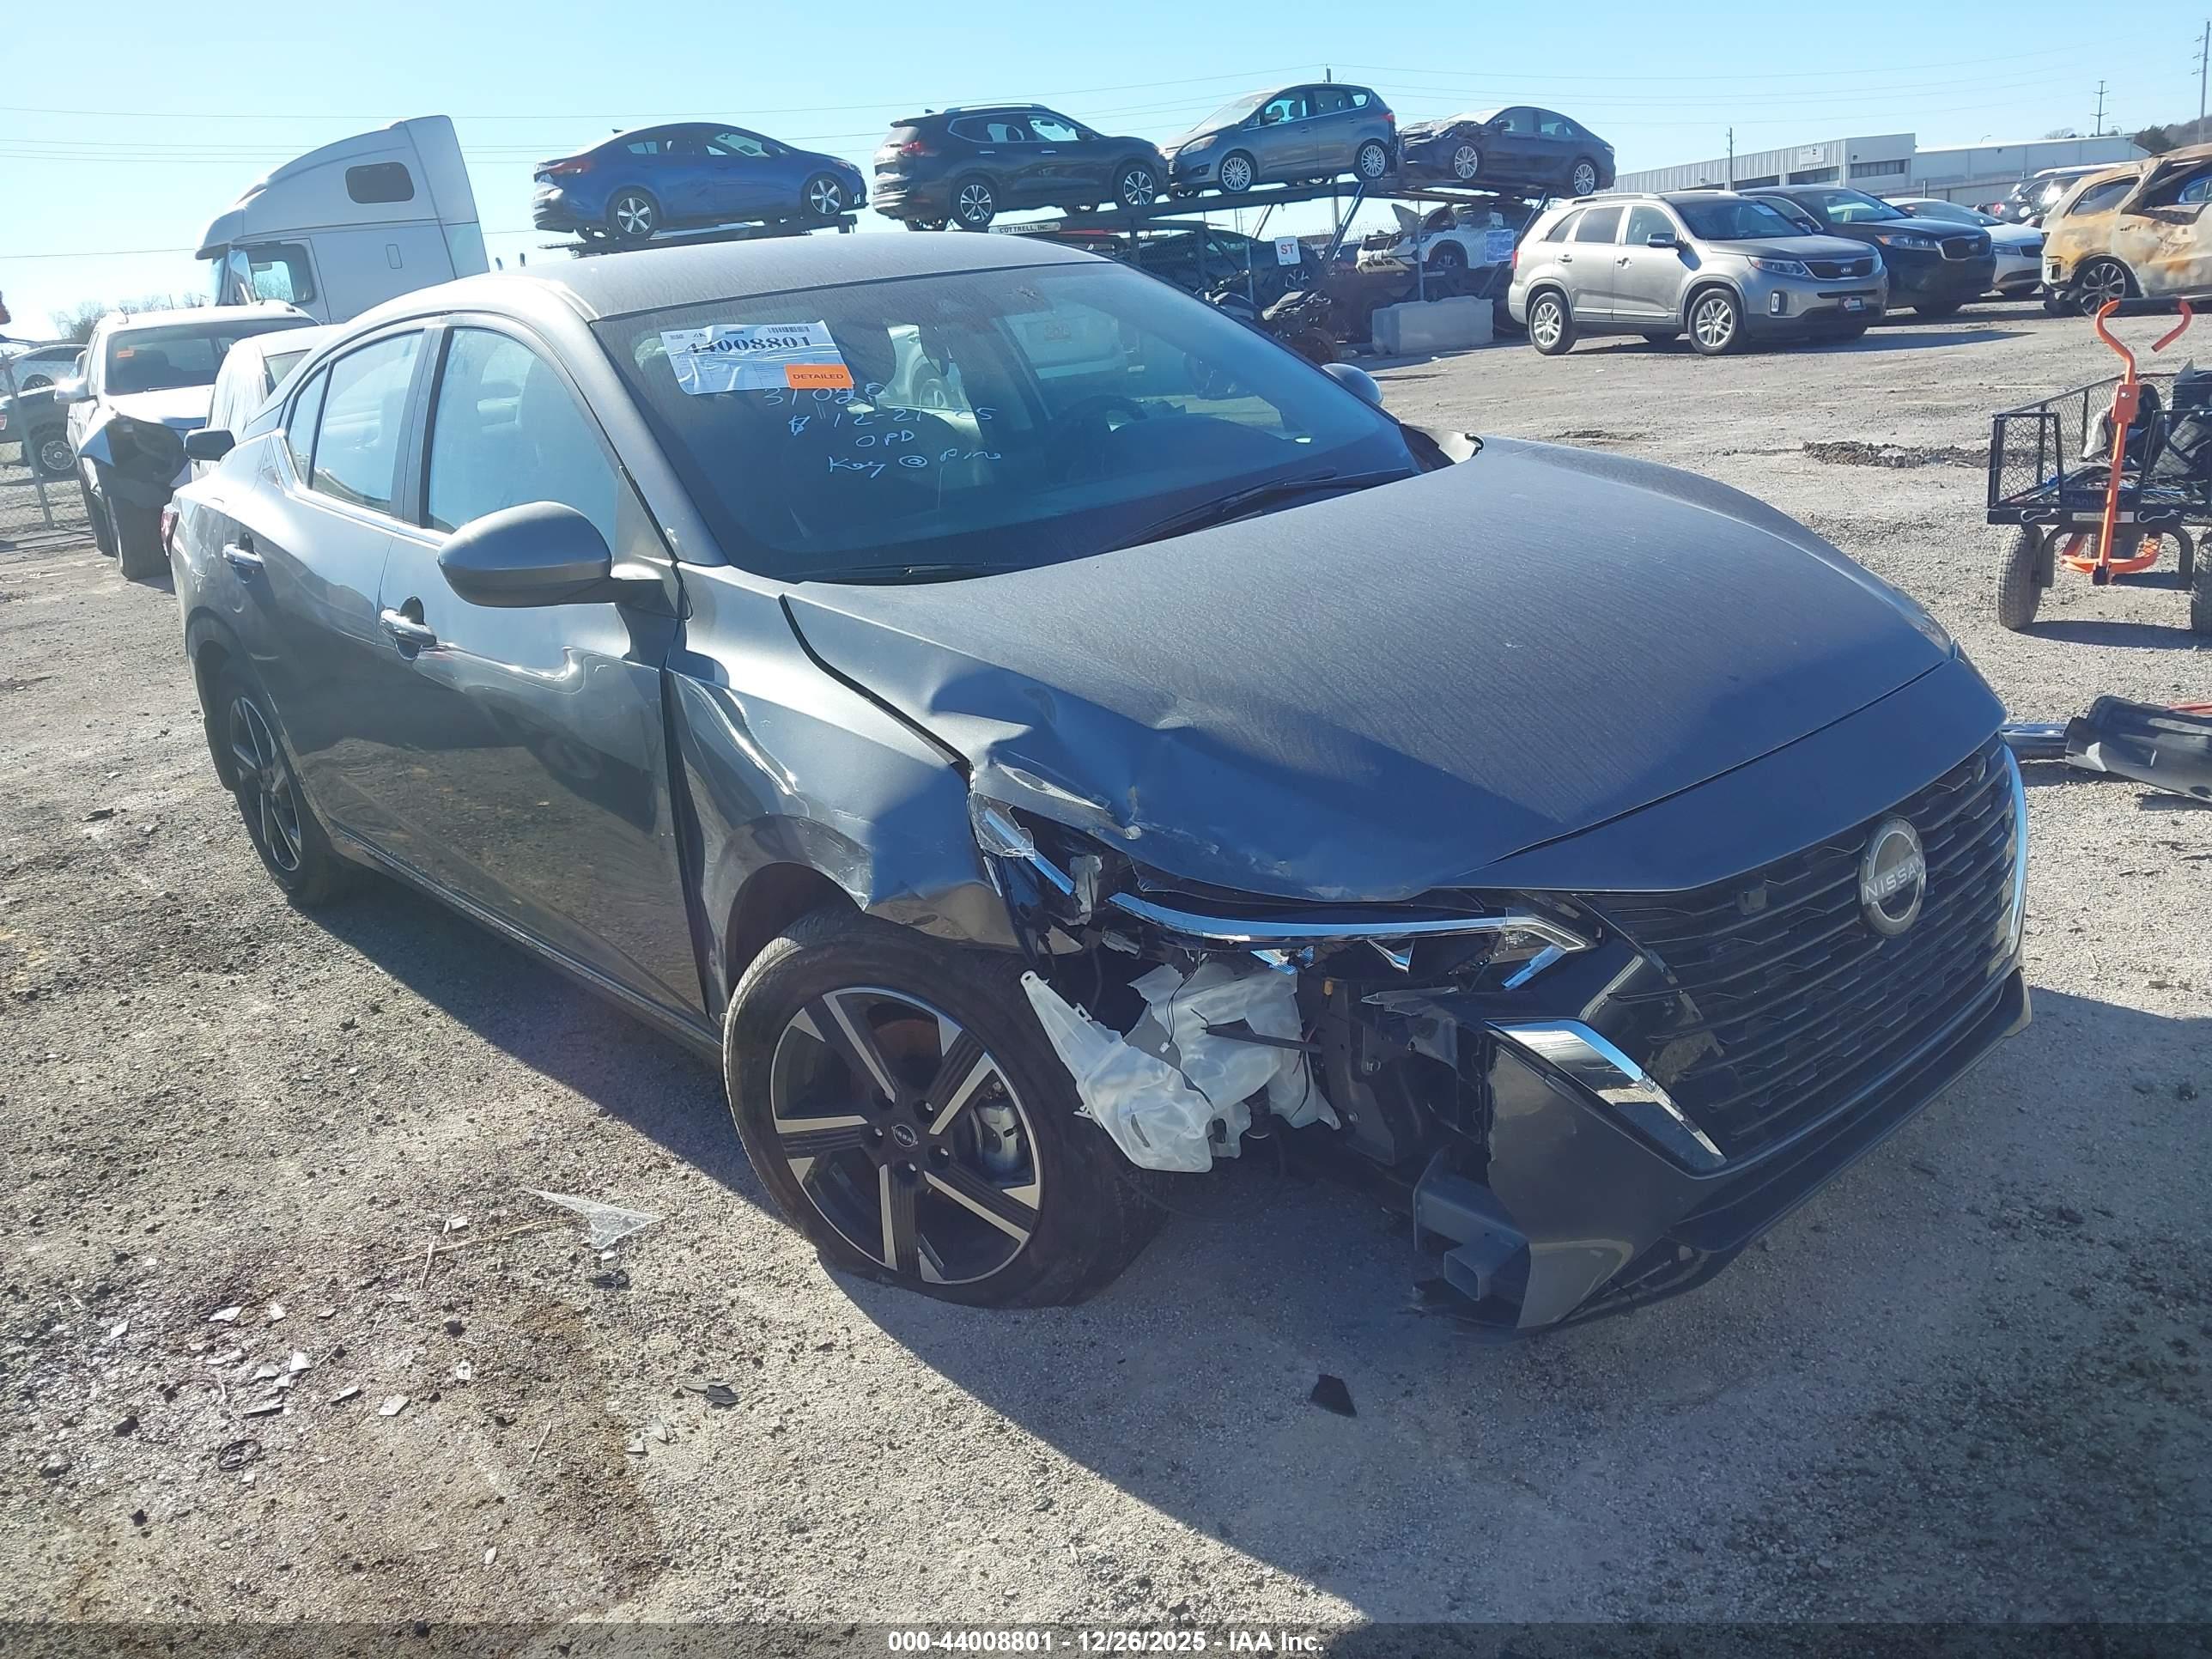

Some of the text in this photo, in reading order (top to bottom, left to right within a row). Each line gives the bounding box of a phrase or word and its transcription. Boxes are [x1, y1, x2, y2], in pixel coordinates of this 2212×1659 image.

[1280, 244, 1294, 255] ST
[898, 455, 928, 468] @
[1864, 856, 1925, 901] NISSAN
